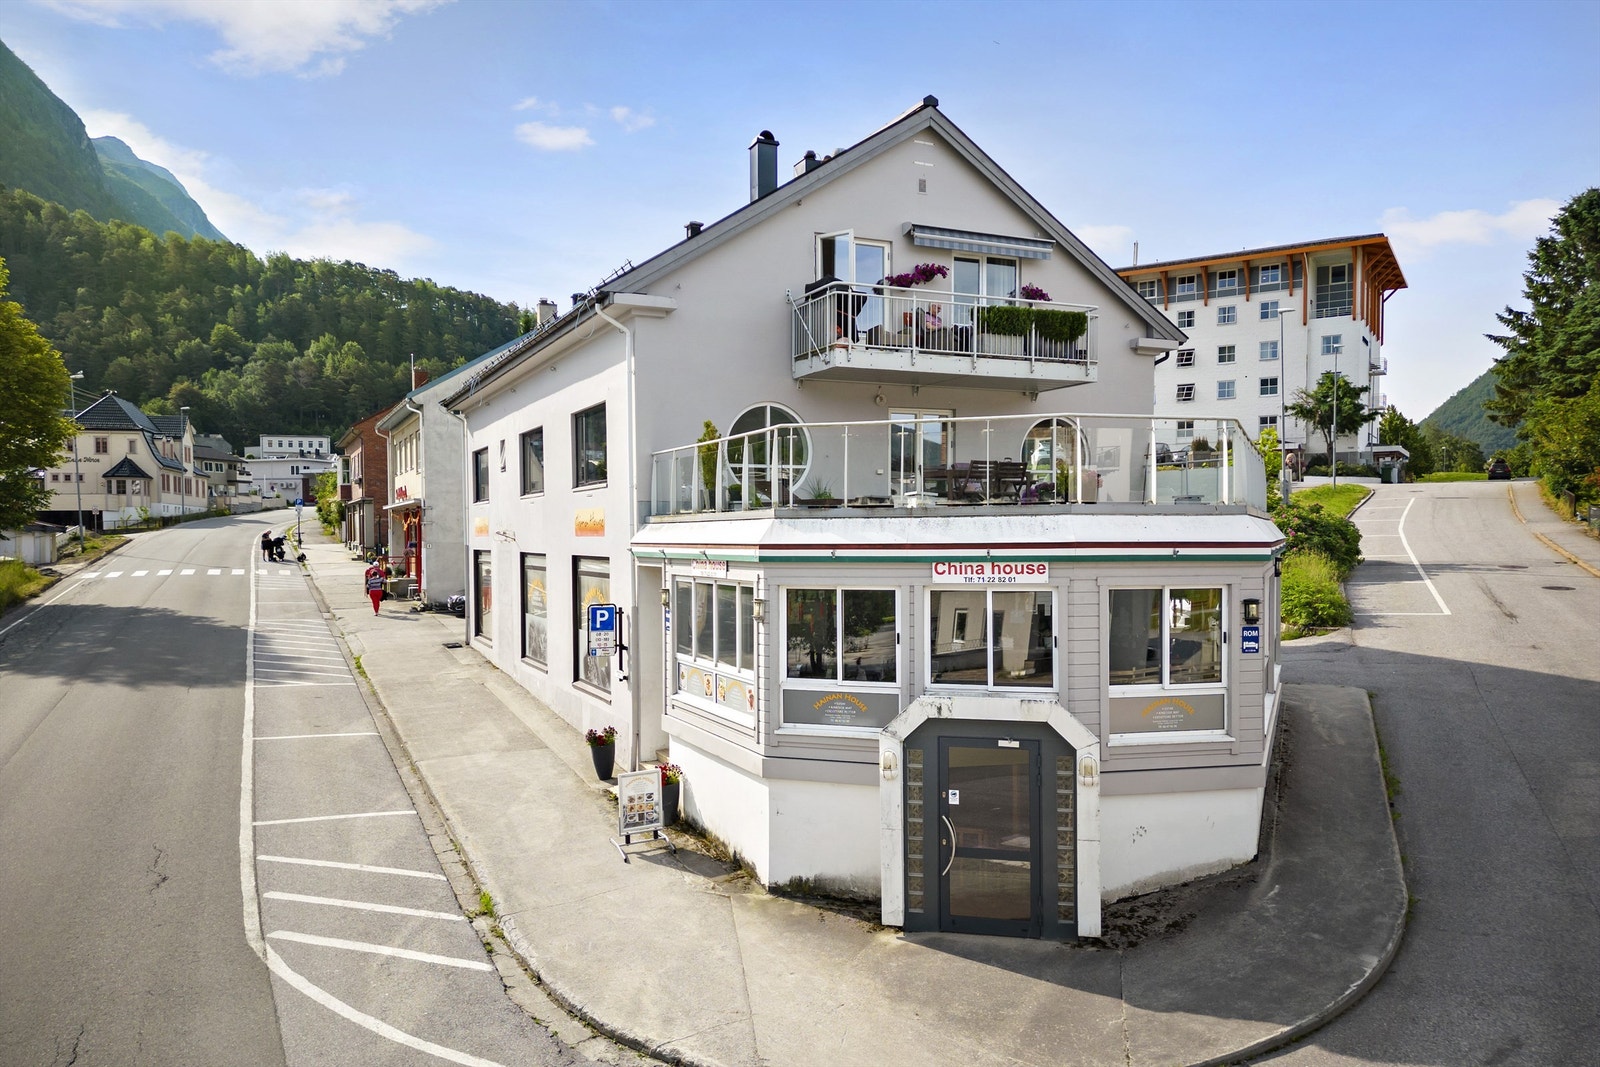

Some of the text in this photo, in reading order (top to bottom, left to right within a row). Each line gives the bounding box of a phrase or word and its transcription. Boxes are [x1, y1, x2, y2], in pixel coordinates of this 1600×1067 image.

[933, 562, 1047, 575] China house
[596, 610, 609, 628] P
[813, 693, 868, 713] HAINAN HOUSE
